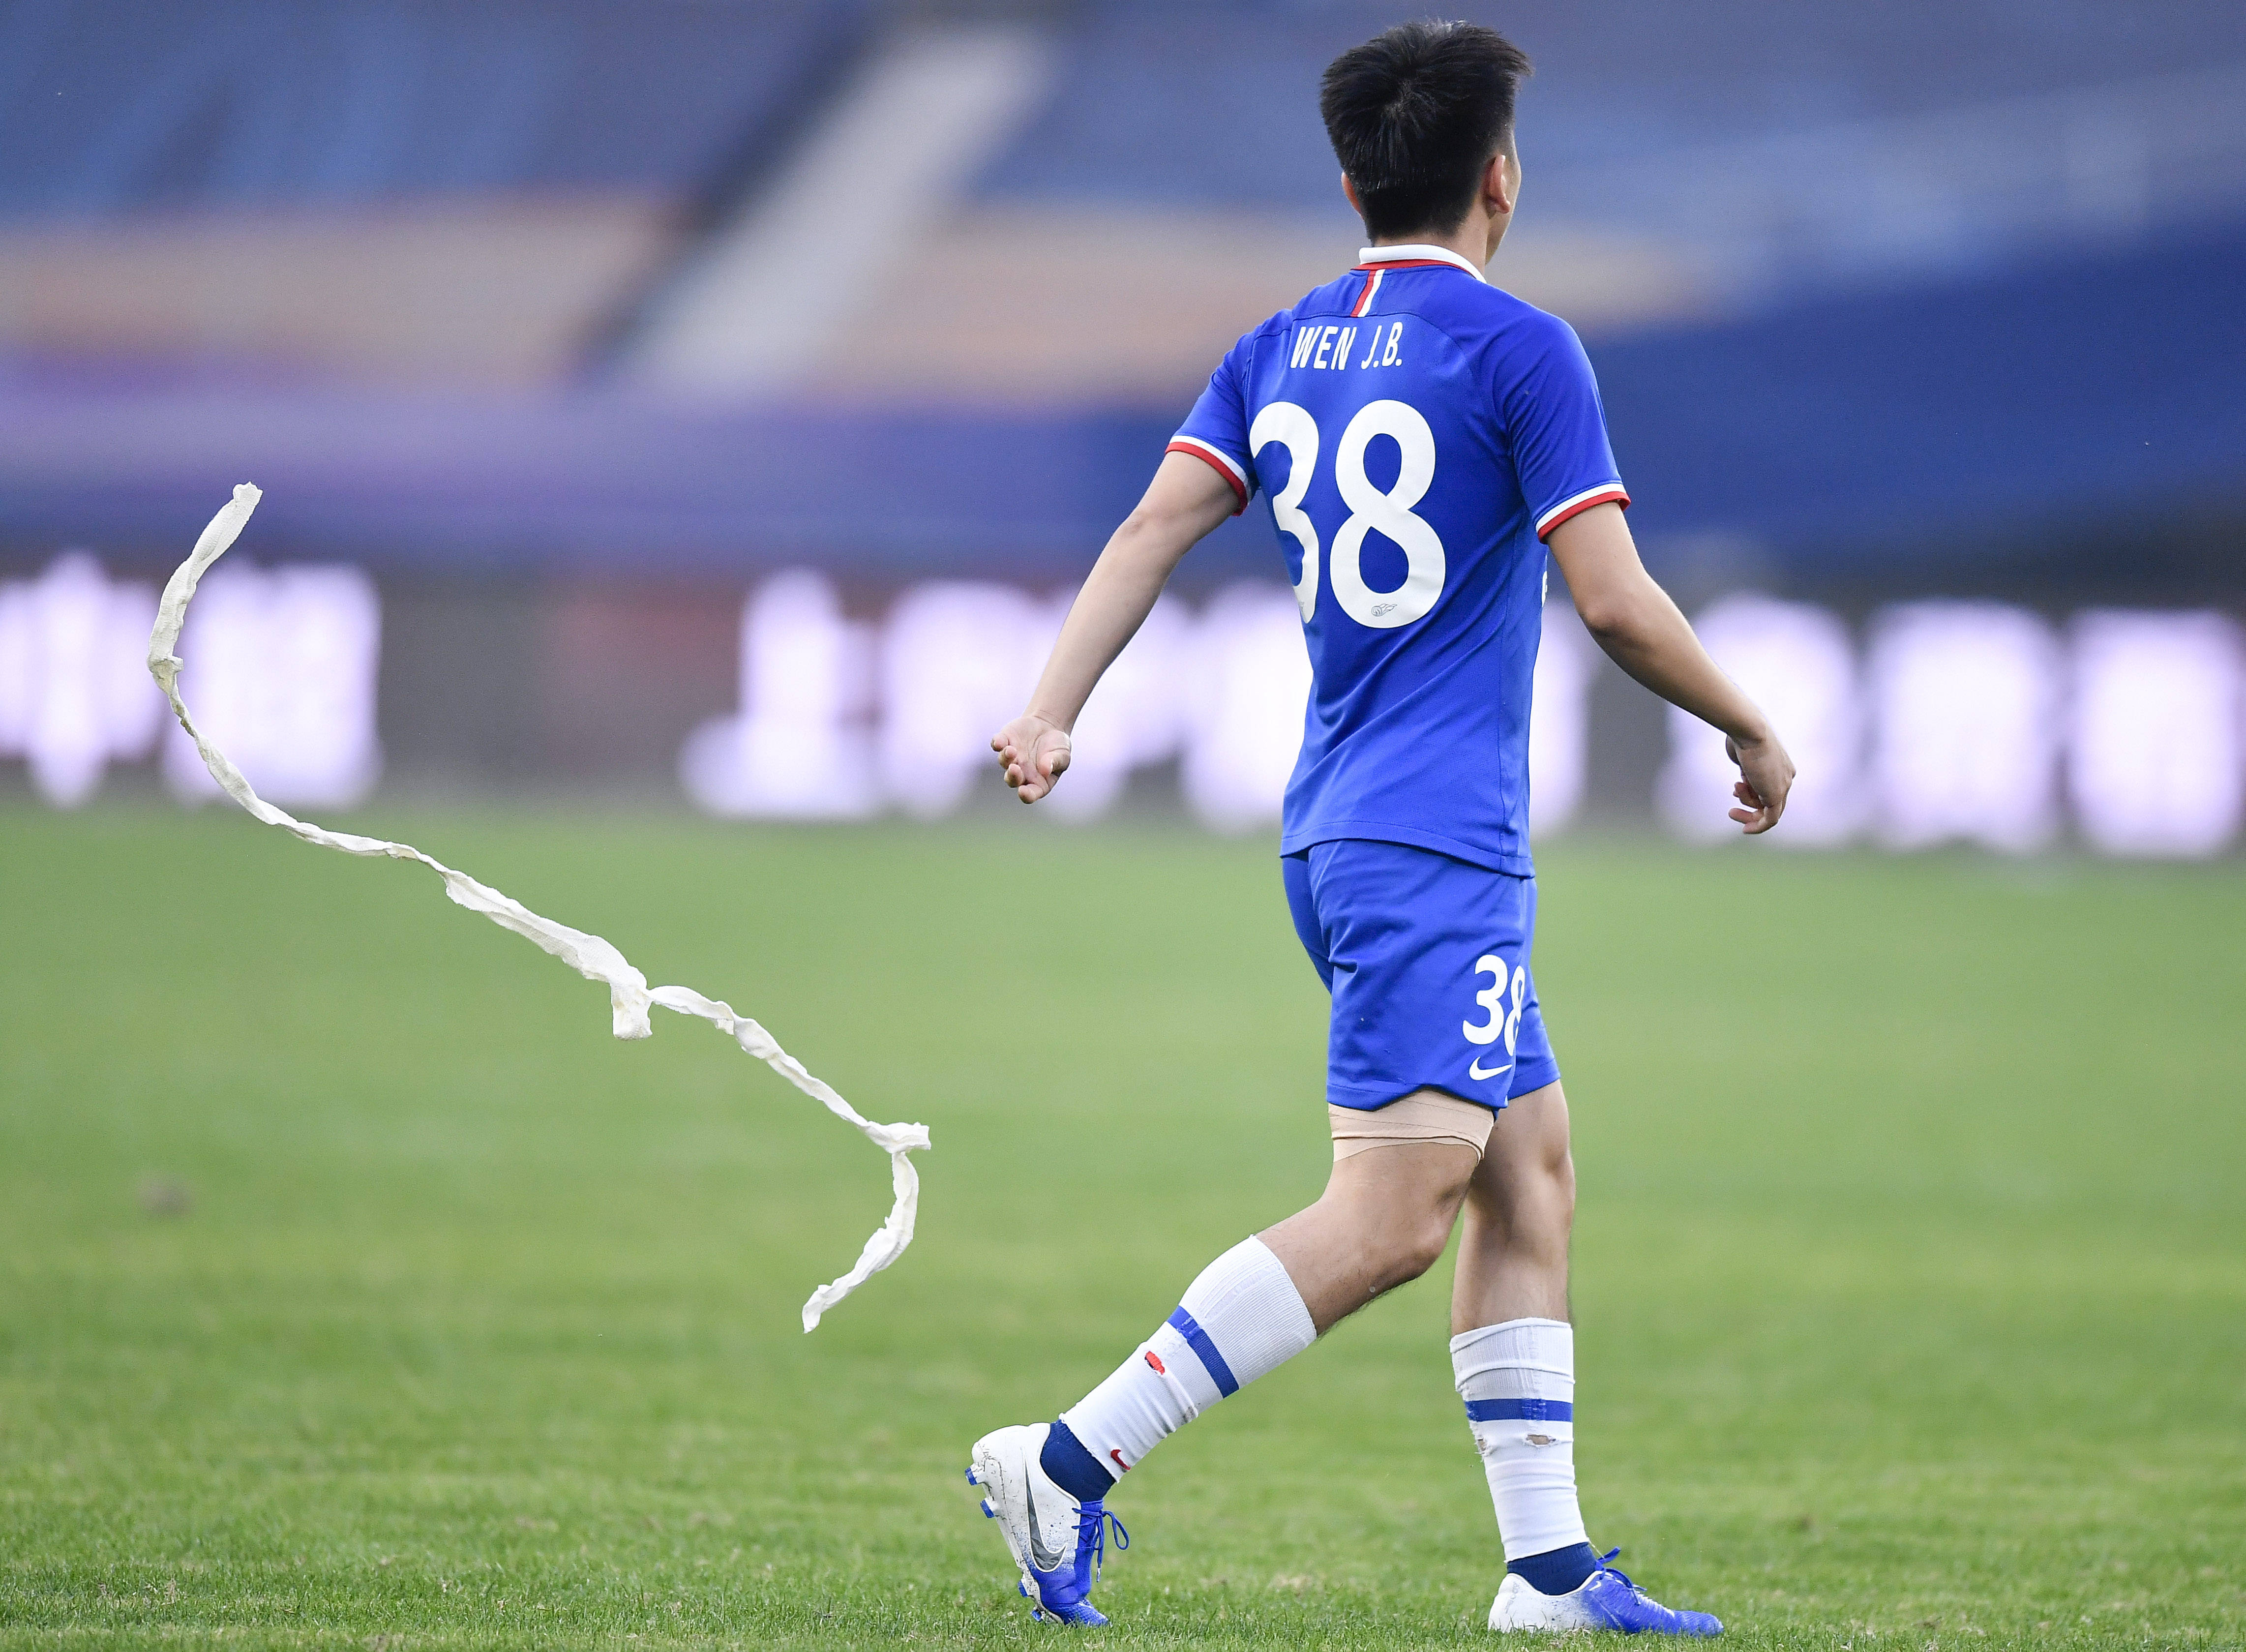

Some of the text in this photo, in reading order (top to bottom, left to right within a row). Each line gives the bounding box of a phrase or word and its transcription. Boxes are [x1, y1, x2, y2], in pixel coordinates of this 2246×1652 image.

[1290, 321, 1404, 370] WEN J.B.
[1249, 399, 1446, 629] 38
[1463, 954, 1525, 1057] 38
